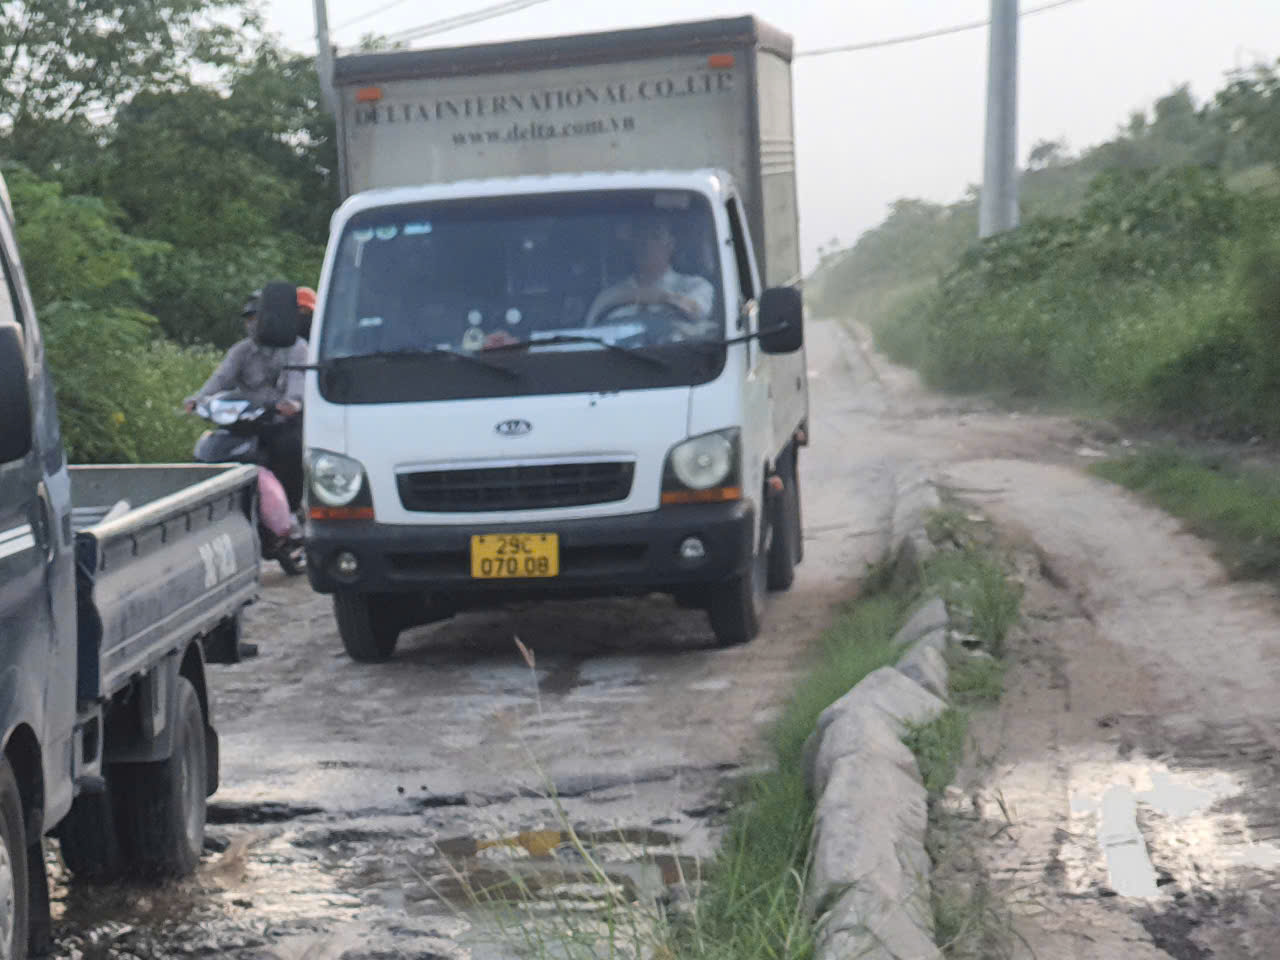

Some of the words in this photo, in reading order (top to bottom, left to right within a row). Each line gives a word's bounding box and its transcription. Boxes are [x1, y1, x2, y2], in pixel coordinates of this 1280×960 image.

[354, 102, 430, 126] DELTA
[434, 83, 632, 120] INTERNATIONAL
[451, 115, 637, 147] www.delta.com.vn
[495, 535, 535, 554] 29C
